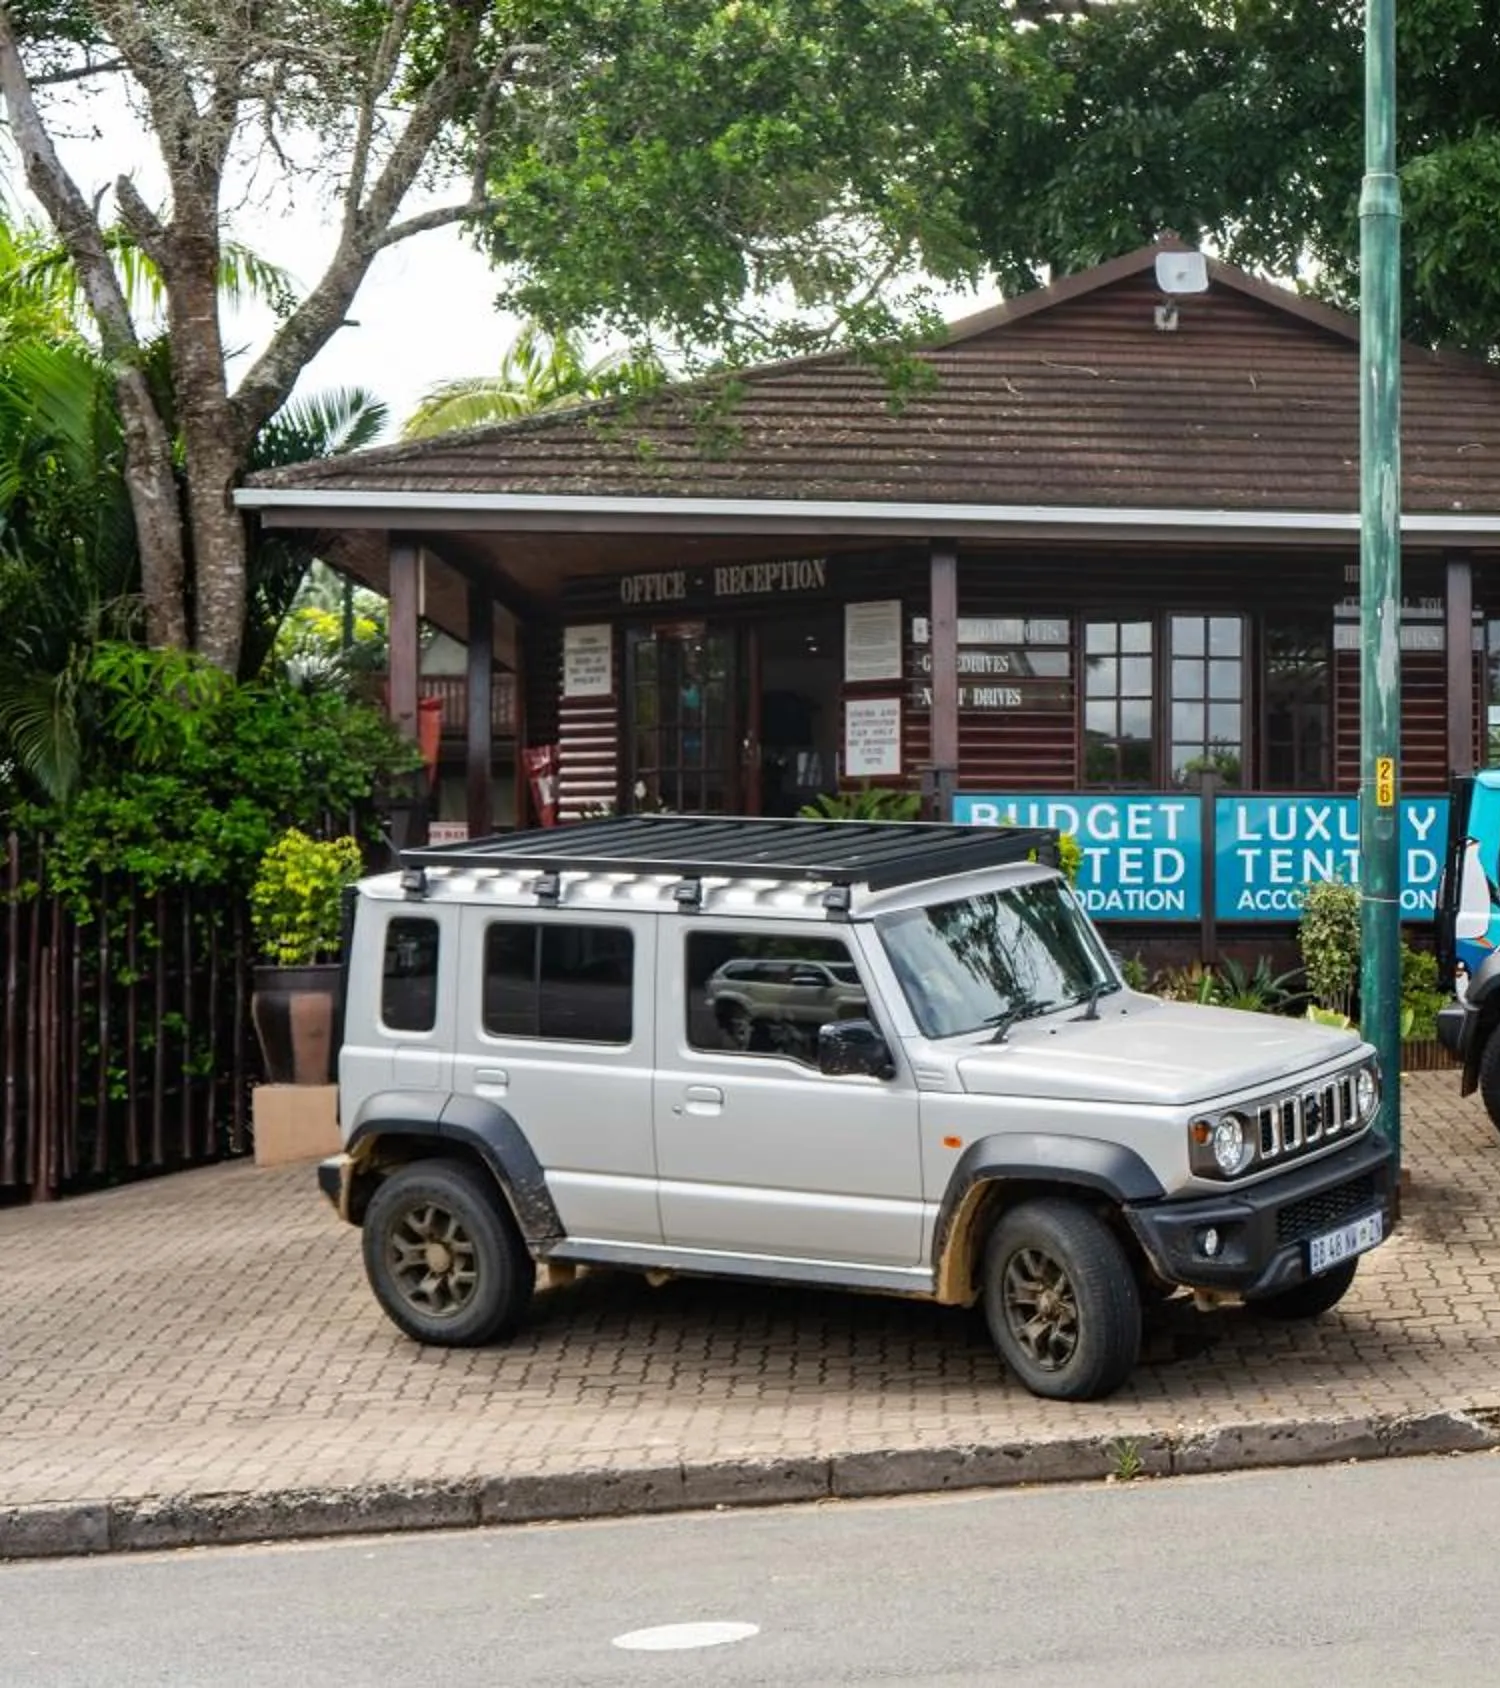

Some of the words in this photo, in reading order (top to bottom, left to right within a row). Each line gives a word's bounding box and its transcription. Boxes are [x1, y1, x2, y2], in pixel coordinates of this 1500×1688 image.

[621, 571, 686, 604] OFFICE
[714, 558, 828, 597] RECEPTION
[973, 687, 1022, 707] DRIVES
[1237, 805, 1437, 842] LUXUY
[1083, 847, 1185, 885] TED
[1237, 847, 1438, 885] TENTD
